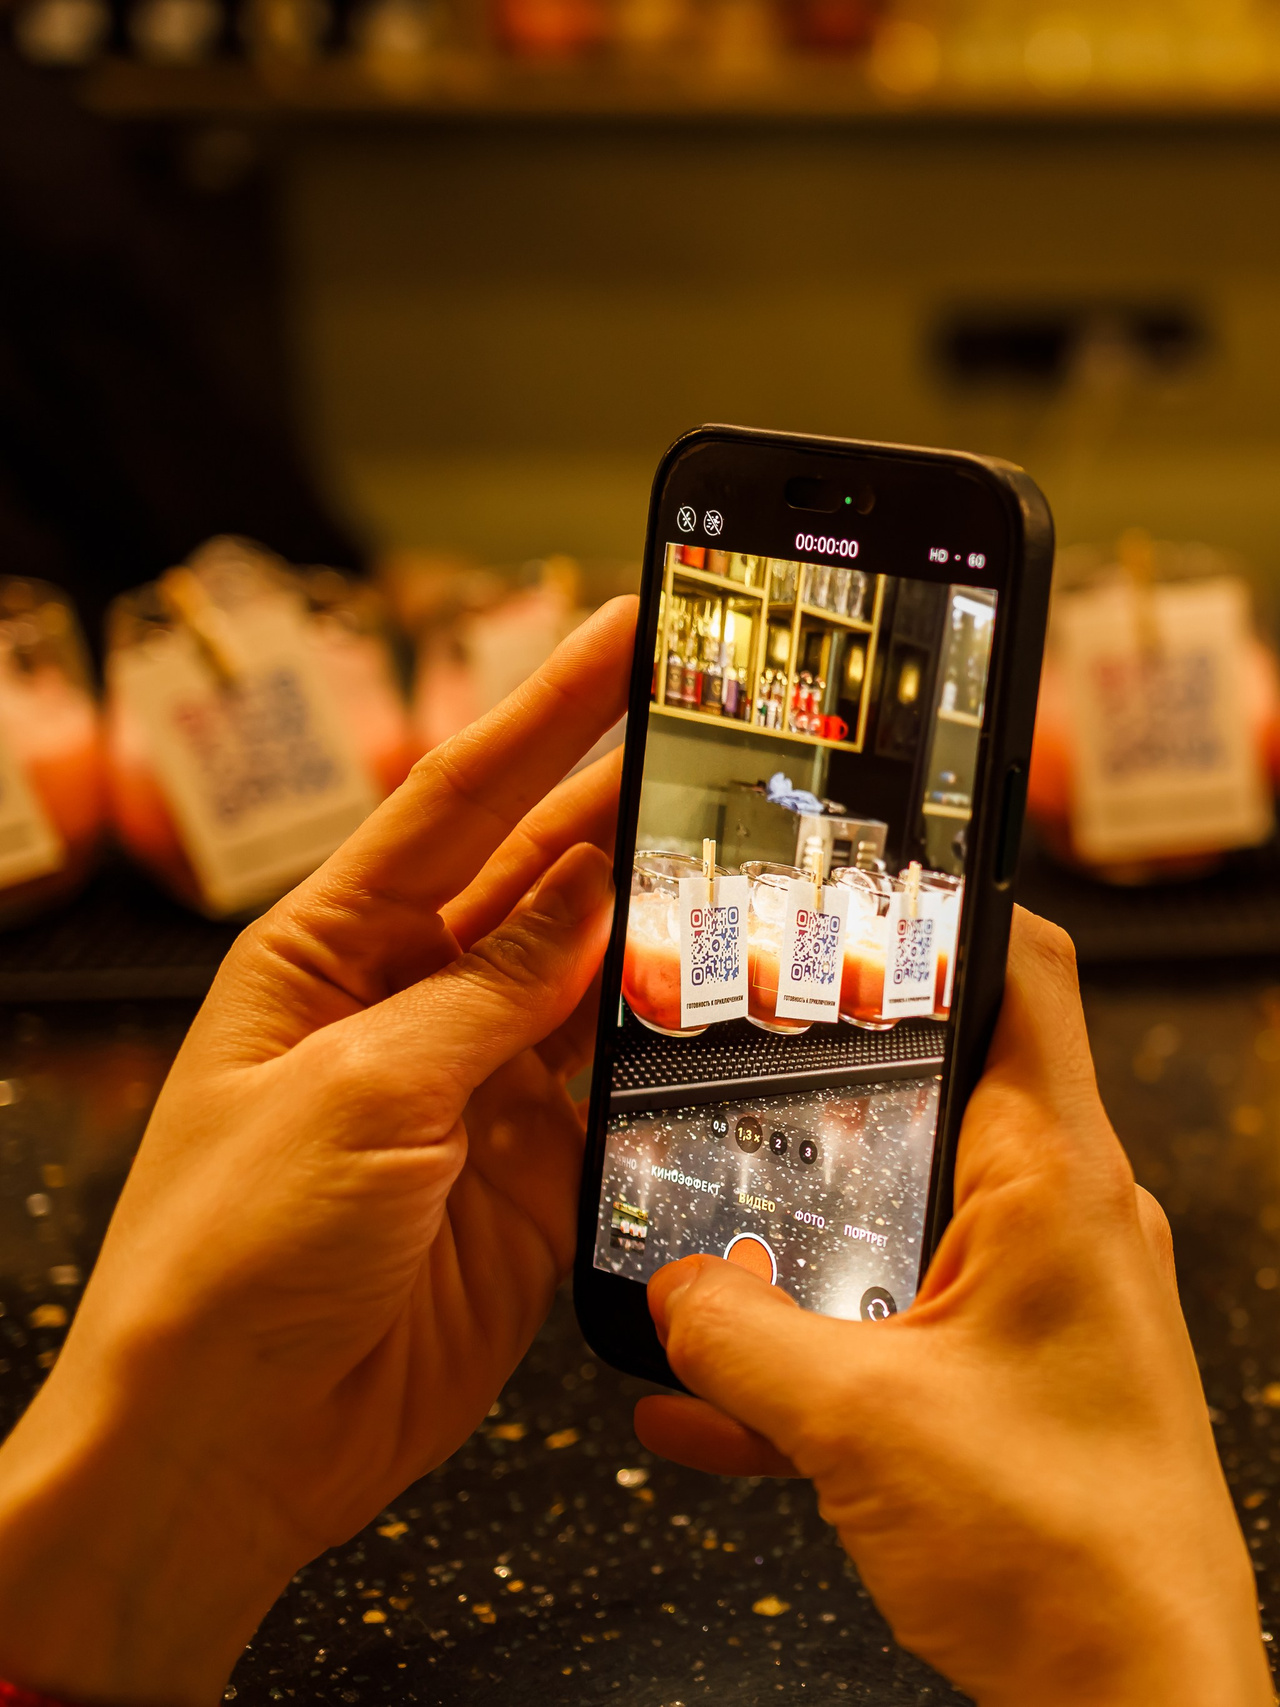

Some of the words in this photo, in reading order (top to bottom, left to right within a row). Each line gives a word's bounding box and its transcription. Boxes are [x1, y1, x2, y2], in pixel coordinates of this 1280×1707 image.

[795, 532, 859, 558] 00:00:00
[929, 547, 949, 564] HD
[713, 1120, 727, 1133] 0,5
[737, 1127, 752, 1141] 1,3
[775, 1138, 782, 1149] 2
[804, 1147, 812, 1157] 3
[650, 1164, 721, 1196] КИНОЭФФЕКТ
[738, 1192, 776, 1213] ВИДЕО
[794, 1209, 826, 1229] ФОТО
[843, 1224, 889, 1248] ПОРТРЕТ
